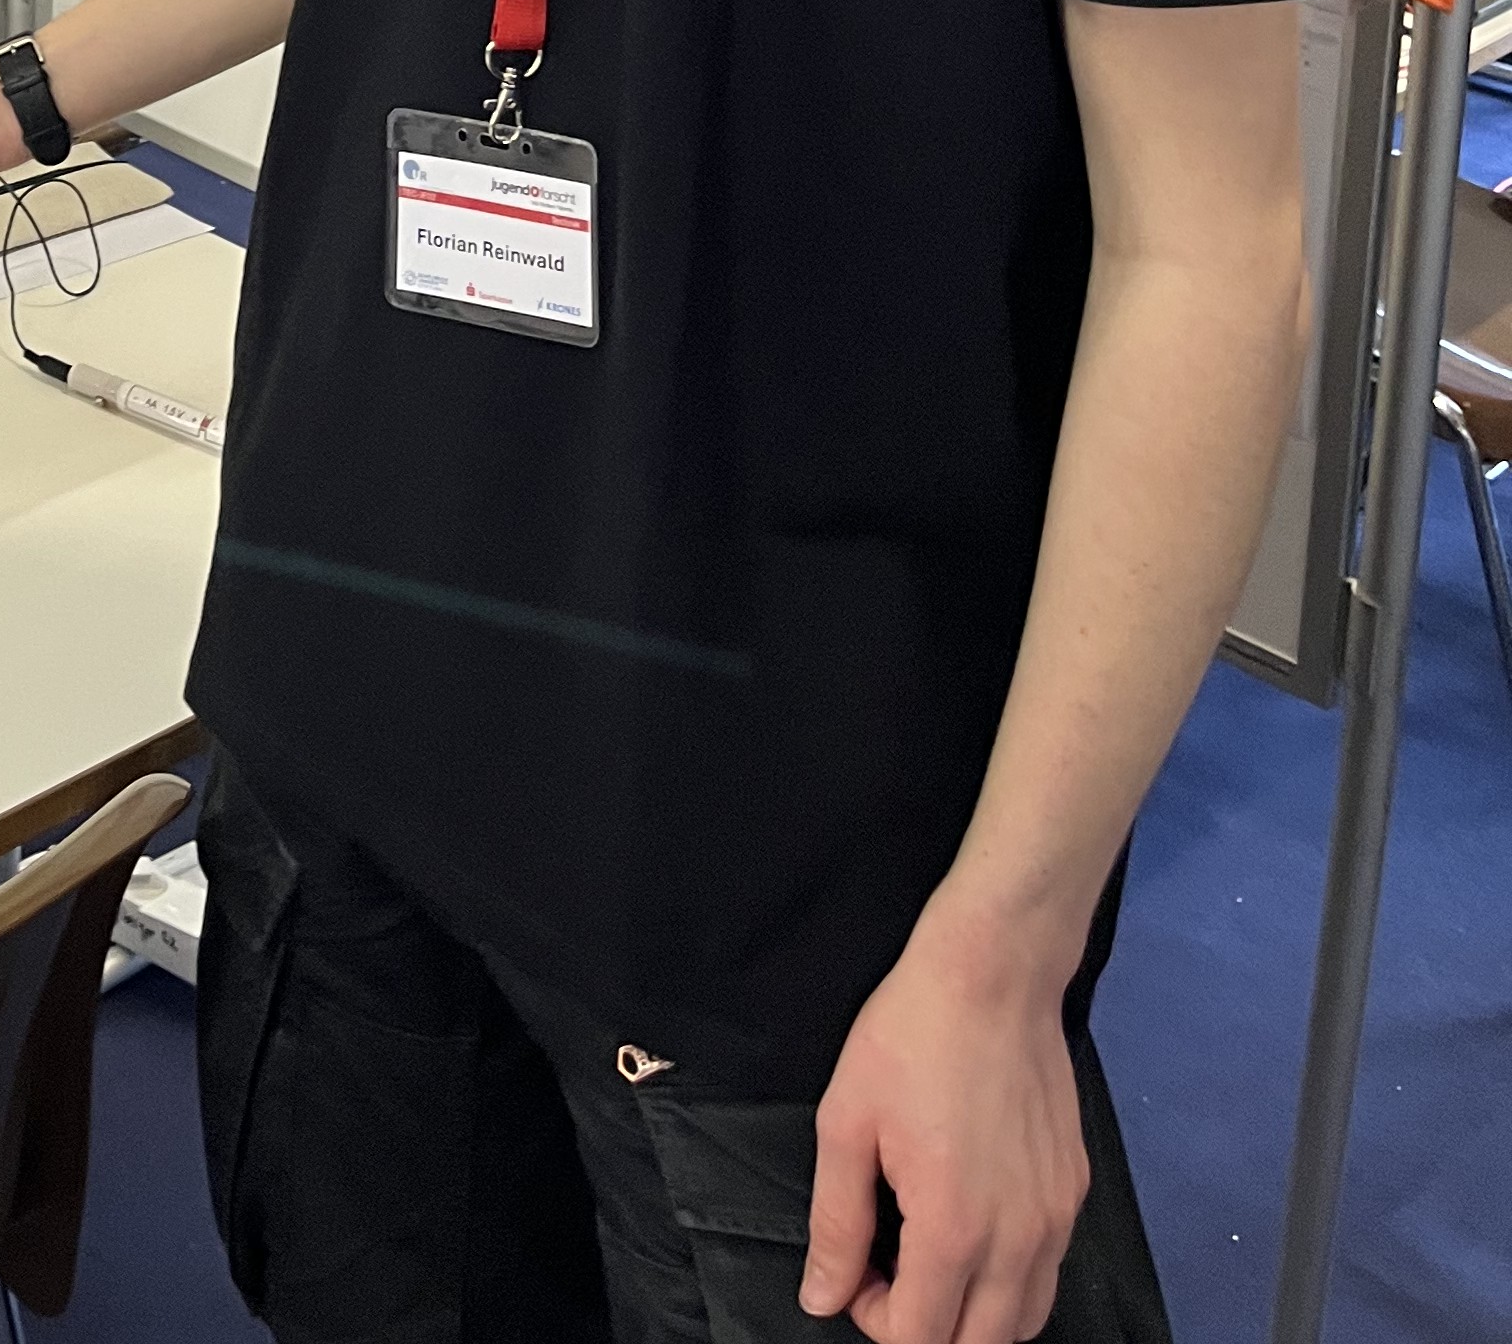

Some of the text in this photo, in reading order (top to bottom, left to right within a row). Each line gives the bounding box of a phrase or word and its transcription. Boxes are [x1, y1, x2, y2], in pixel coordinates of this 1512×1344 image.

[417, 228, 566, 273] Florian Reinwald
[546, 301, 582, 317] KRONES
